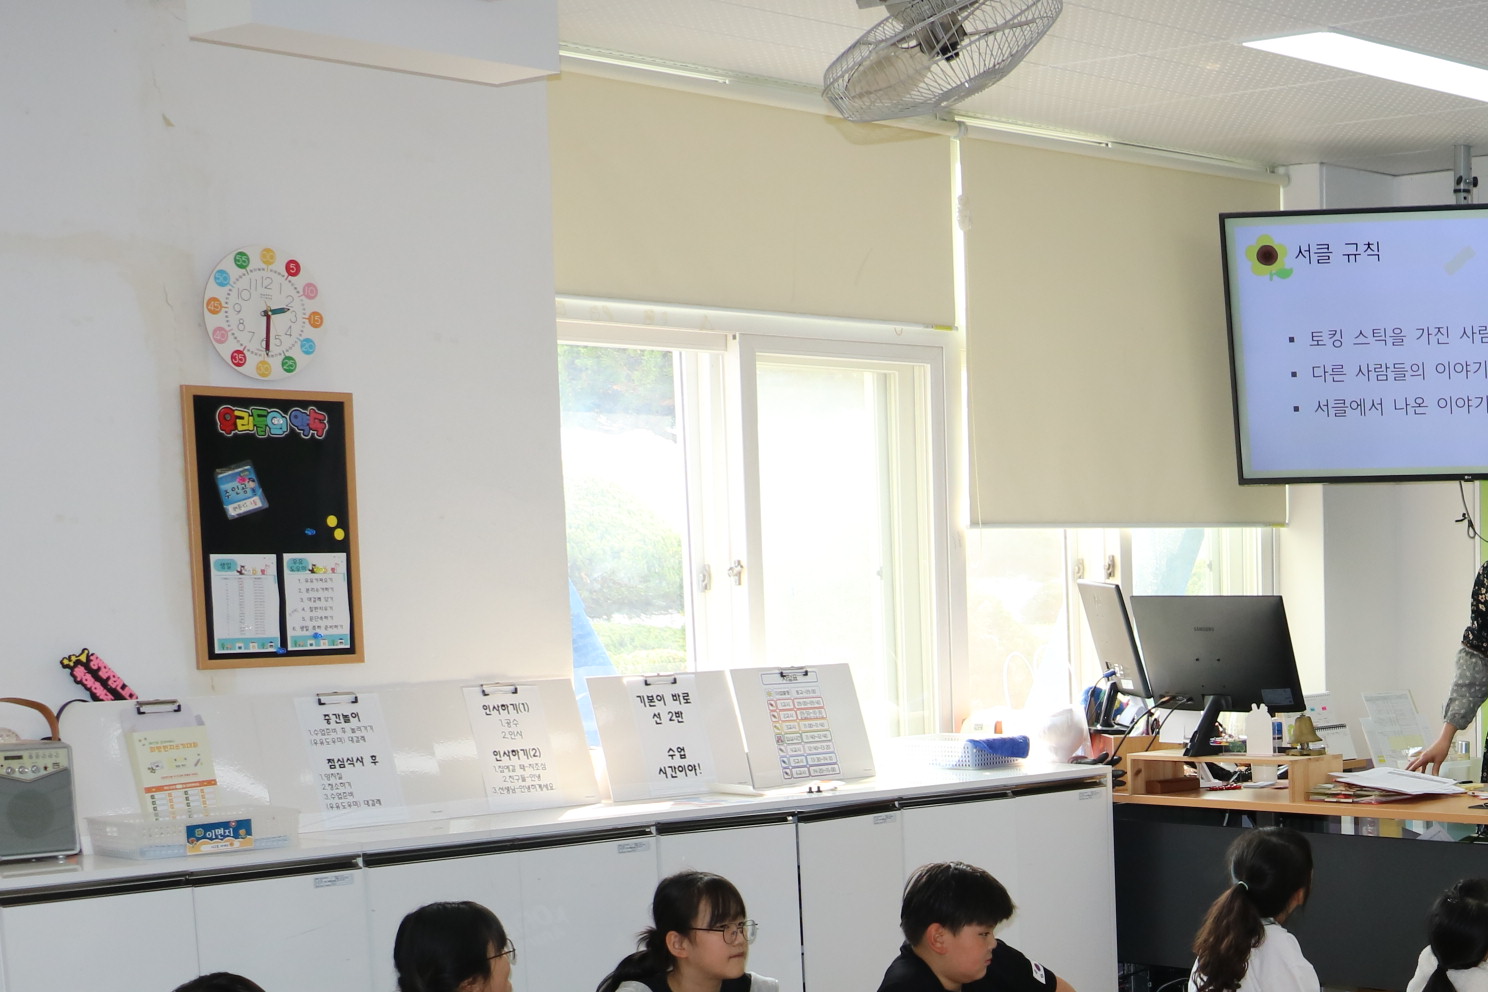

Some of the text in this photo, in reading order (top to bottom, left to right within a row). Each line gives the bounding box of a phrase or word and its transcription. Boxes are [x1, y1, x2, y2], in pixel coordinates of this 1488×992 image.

[1295, 241, 1381, 264] 서클 규칙
[235, 255, 248, 265] 55
[290, 264, 296, 272] 5
[262, 276, 273, 289] 12
[238, 288, 251, 301] 10
[286, 295, 294, 307] 2
[208, 302, 220, 311] 45
[233, 303, 242, 315] 9
[290, 311, 297, 323] 3
[310, 316, 321, 325] 15
[237, 318, 245, 331] 8
[247, 331, 255, 342] 7
[285, 326, 292, 337] 4
[1309, 329, 1343, 348] 토킹
[1354, 326, 1407, 347] 스틱을
[1416, 325, 1450, 346] 가진
[275, 335, 282, 346] 5
[233, 353, 244, 363] 35
[283, 360, 295, 369] 25
[1312, 364, 1346, 383] 다른
[1355, 362, 1426, 382] 사람들의
[1435, 359, 1488, 380] 이야기
[1314, 398, 1384, 418] 서클에서
[1394, 396, 1428, 416] 나온
[216, 405, 328, 440] 우리들의 약속
[635, 692, 692, 708] 기본이 바로
[482, 702, 530, 716] 인사하기(1)
[323, 712, 361, 725] 중간놀이
[652, 711, 685, 725] 선 2반
[492, 747, 541, 762] 인사하기(2)
[667, 746, 687, 760] 수업
[326, 755, 379, 770] 점심식사 후
[658, 762, 703, 780] 시간이야!
[206, 827, 234, 839] 이면지
